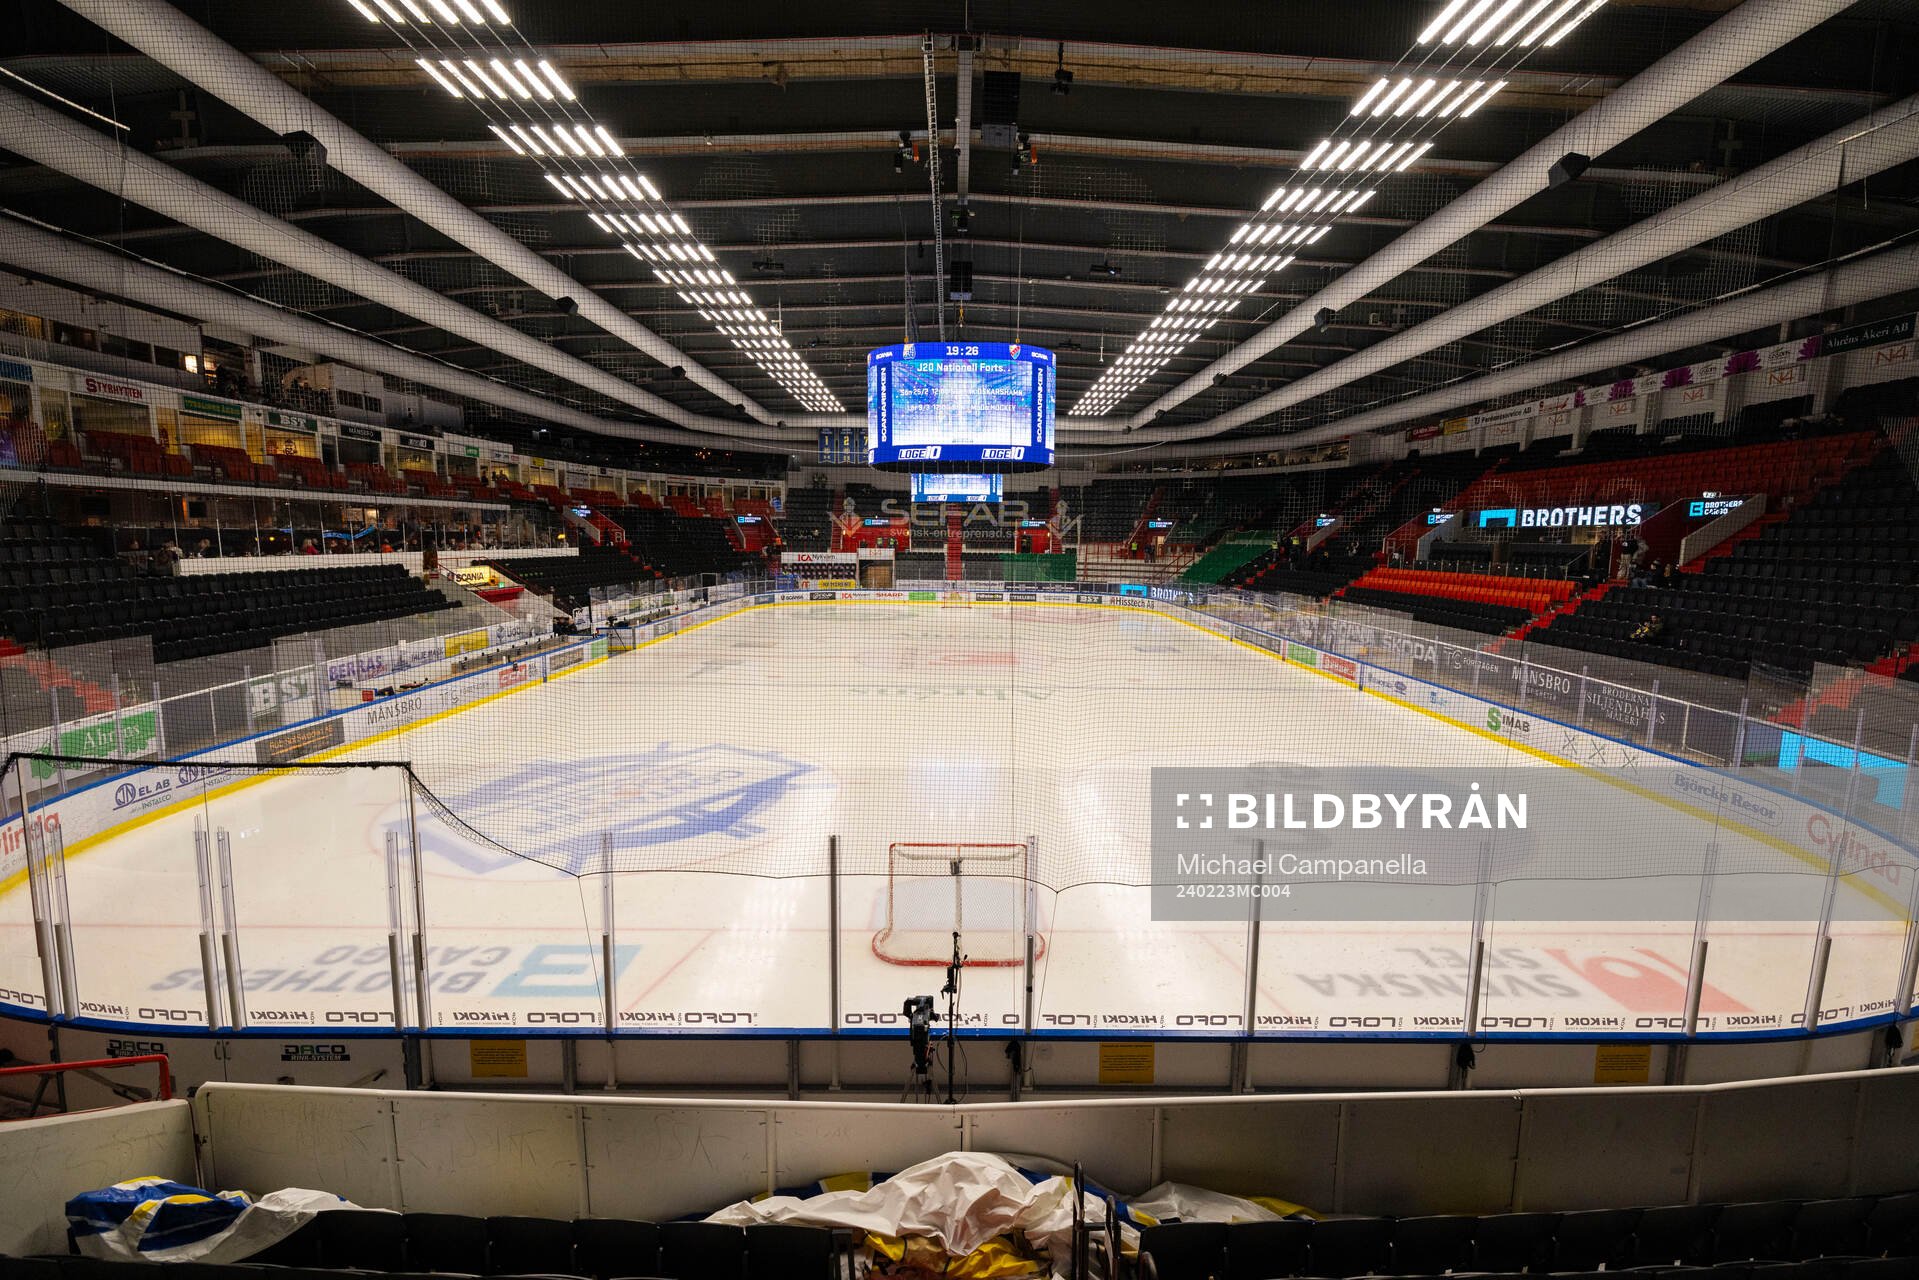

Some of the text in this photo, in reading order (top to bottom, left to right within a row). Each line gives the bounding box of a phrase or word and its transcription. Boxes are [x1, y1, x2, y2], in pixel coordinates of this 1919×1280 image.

[1893, 322, 1909, 335] AB
[946, 346, 979, 356] 19:26
[917, 363, 934, 373] J20
[936, 363, 977, 373] Nationell
[881, 498, 1029, 527] SEFAB
[1521, 504, 1641, 527] BROTHERS
[890, 528, 1019, 540] svensk-entreprenad.se
[798, 554, 812, 562] ICA
[455, 571, 484, 584] SCANIA
[1115, 597, 1146, 609] Hisstech
[138, 786, 153, 797] EL
[155, 778, 171, 792] AB
[1673, 772, 1777, 821] Björcks Resor
[1807, 812, 1901, 887] Cylinda
